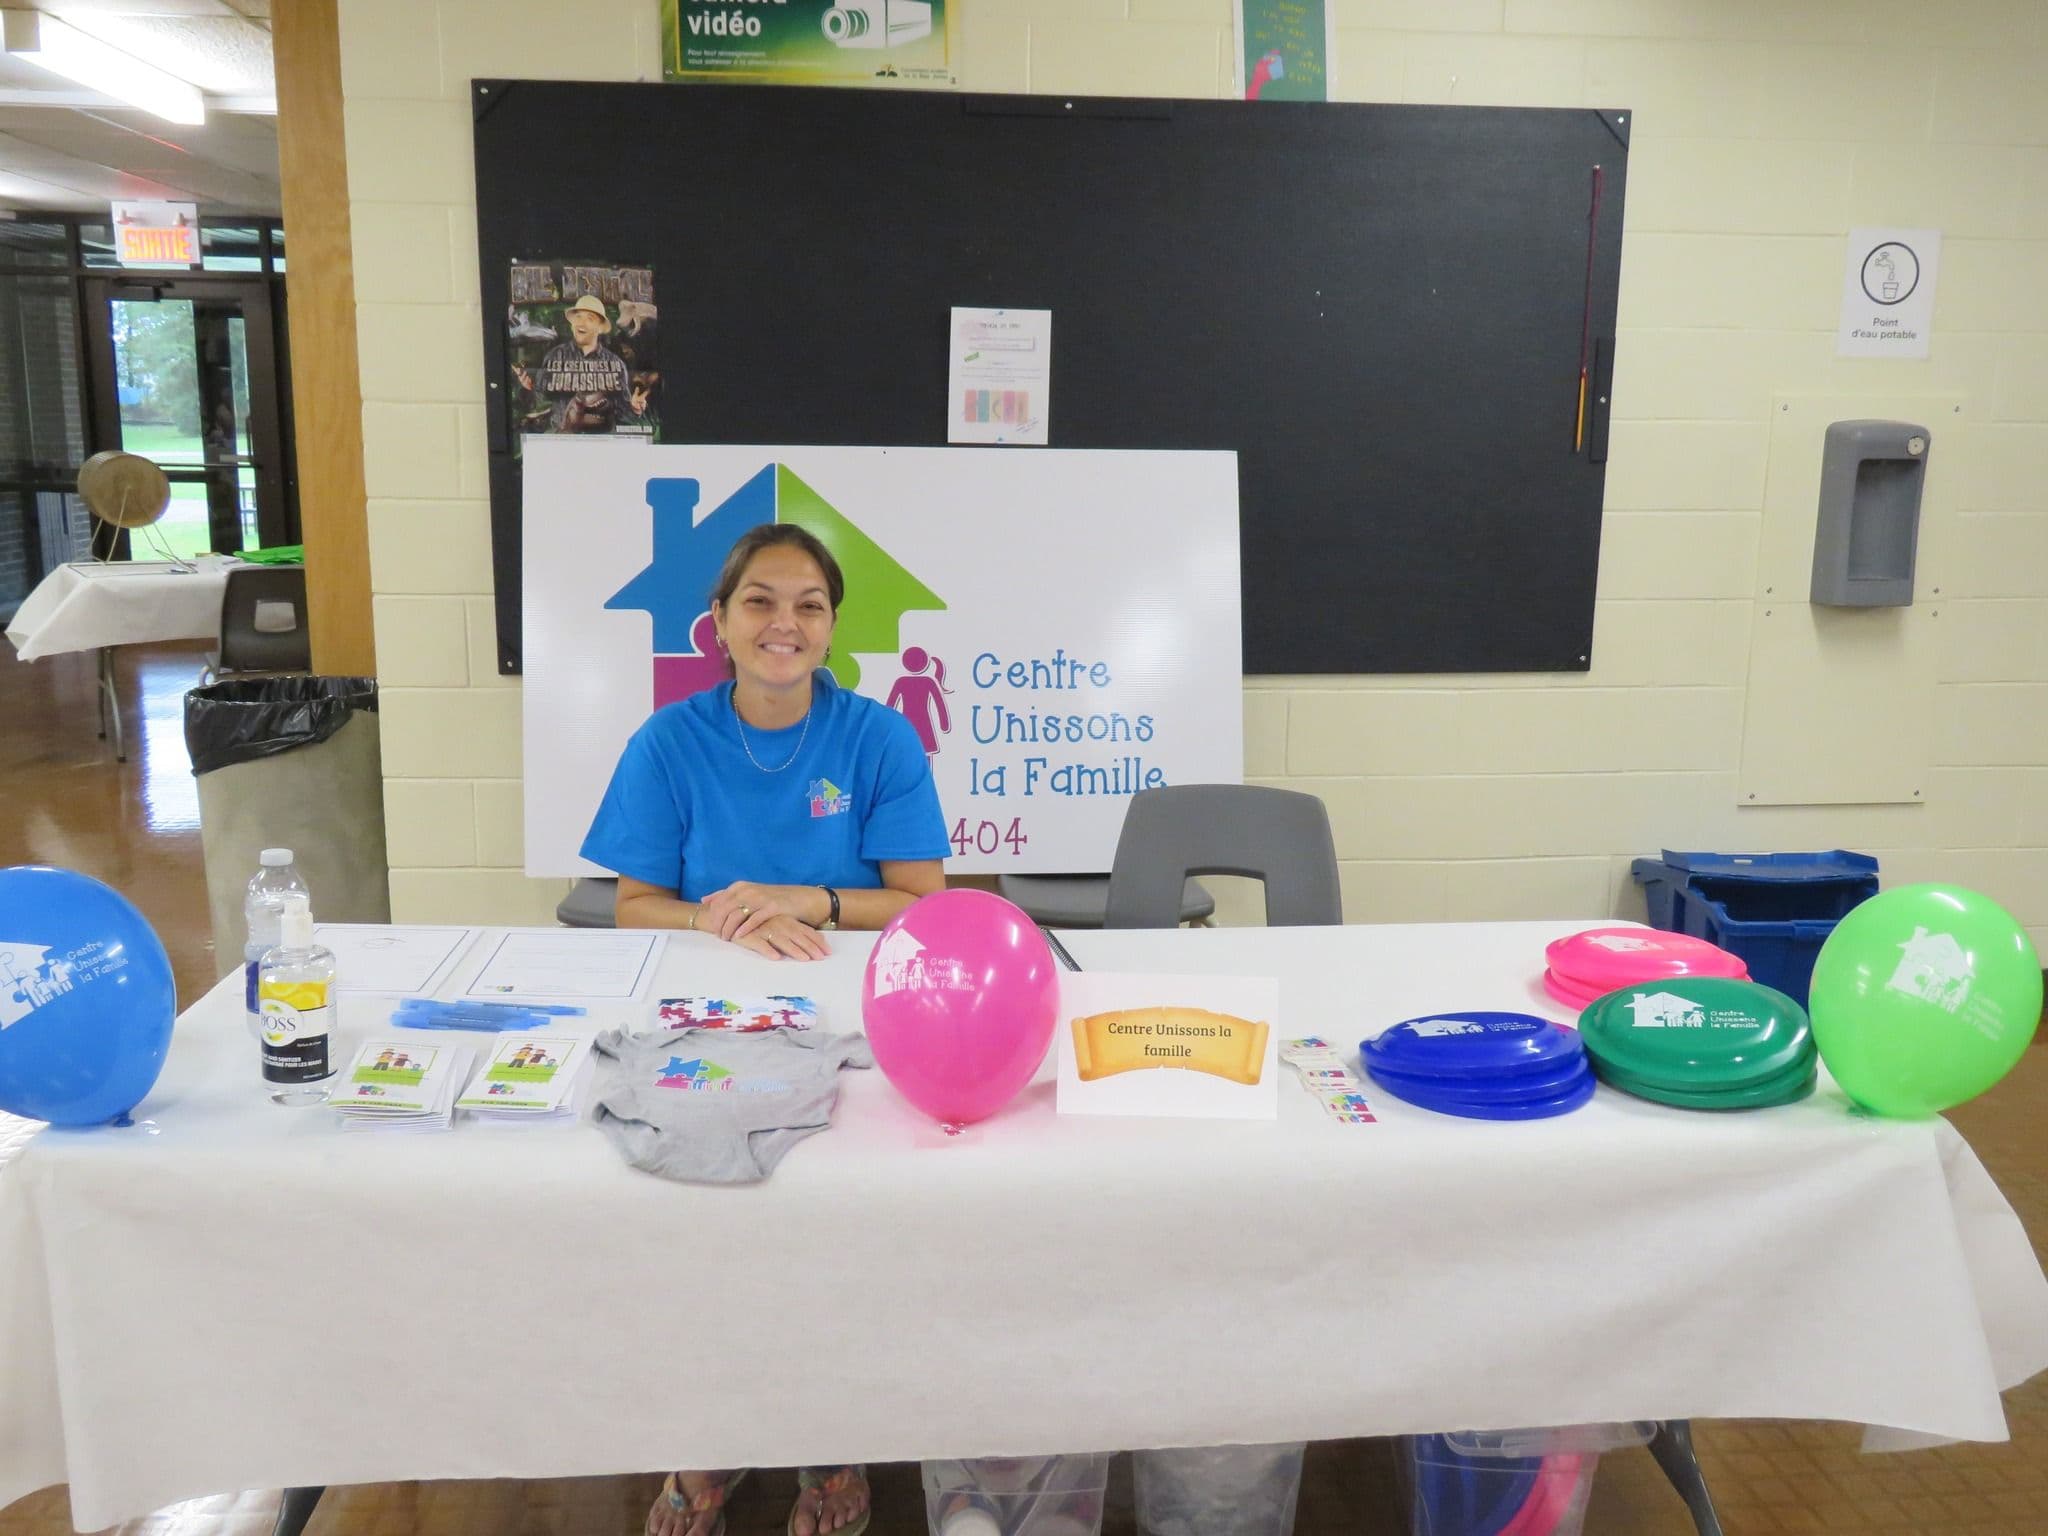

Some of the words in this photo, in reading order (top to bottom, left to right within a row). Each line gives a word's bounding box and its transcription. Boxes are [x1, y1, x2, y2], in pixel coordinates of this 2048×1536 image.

[687, 10, 762, 37] vidéo
[1872, 317, 1899, 328] Point
[1851, 328, 1878, 339] d'eau
[1880, 329, 1918, 340] potable
[546, 360, 562, 372] LES
[546, 372, 622, 392] JURASSIQUE
[972, 649, 1112, 690] Centre
[972, 705, 1154, 744] Unissons
[970, 757, 1007, 797] la
[1023, 757, 1168, 796] Famille
[950, 817, 1028, 856] 404
[1107, 1022, 1153, 1036] Centre
[1155, 1023, 1216, 1037] Unissons
[1218, 1024, 1232, 1037] la
[1143, 1044, 1192, 1058] famille
